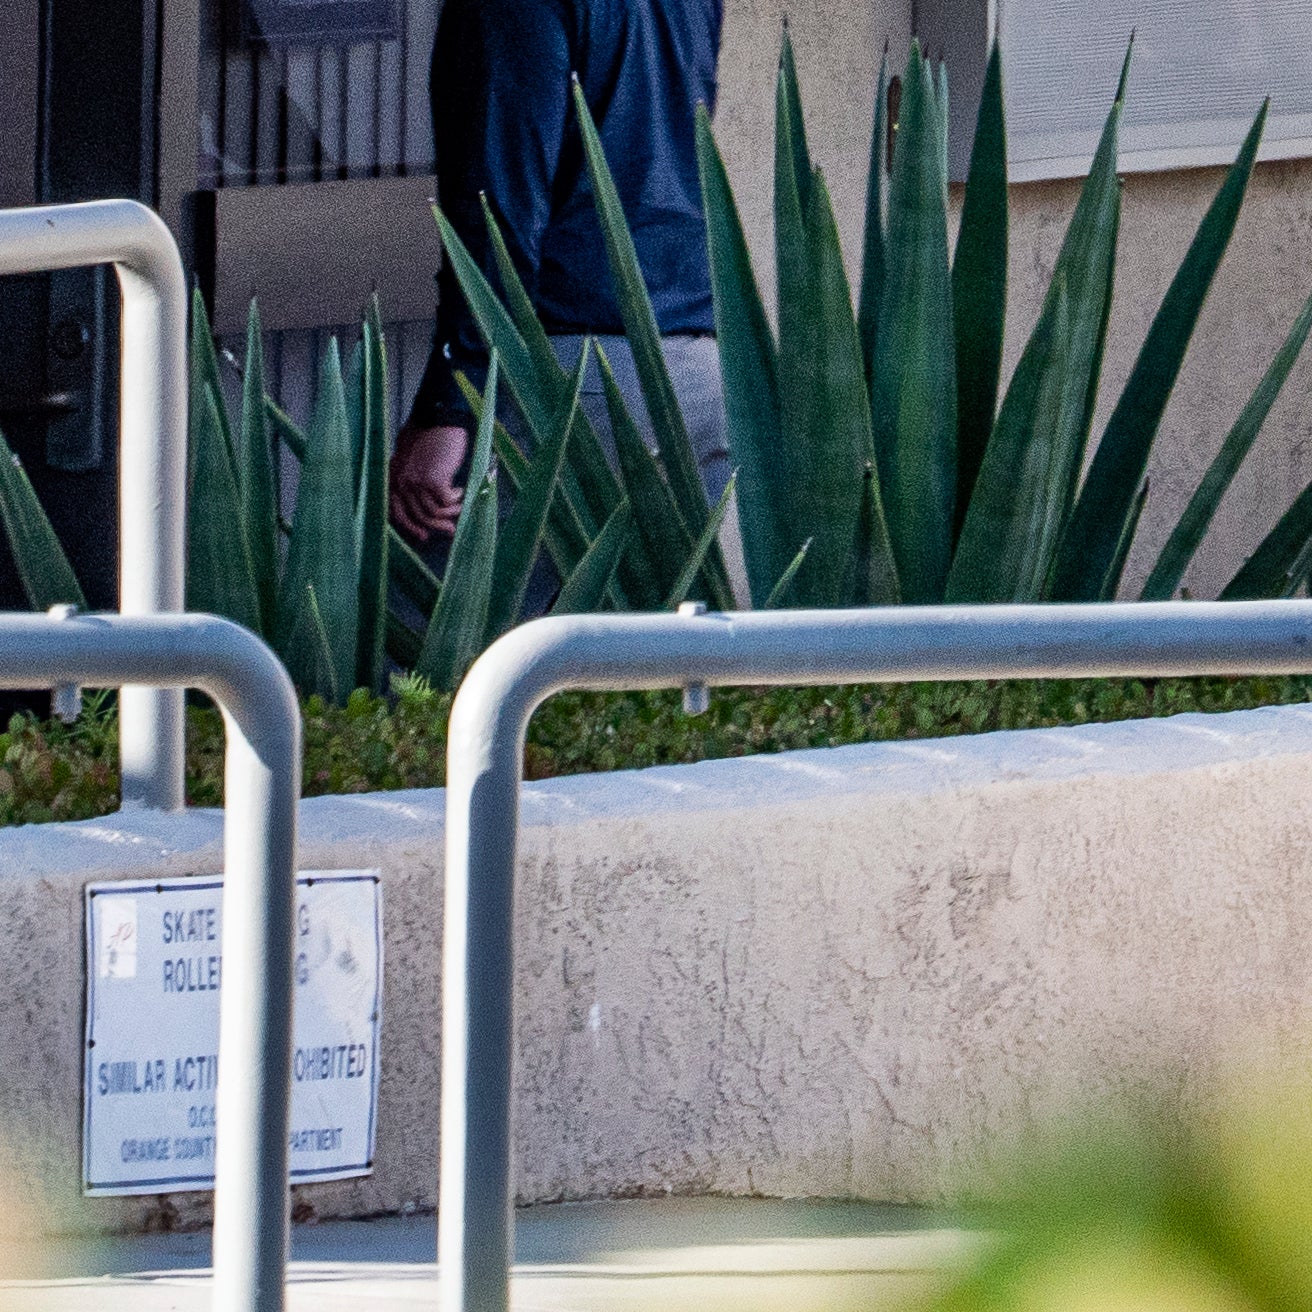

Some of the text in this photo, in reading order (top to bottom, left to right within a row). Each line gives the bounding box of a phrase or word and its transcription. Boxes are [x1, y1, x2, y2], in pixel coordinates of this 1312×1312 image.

[162, 908, 216, 944] SKATE
[98, 1060, 167, 1096] SIMILAR
[294, 1043, 366, 1082] OHIBITED
[174, 1135, 215, 1161] COUNT
